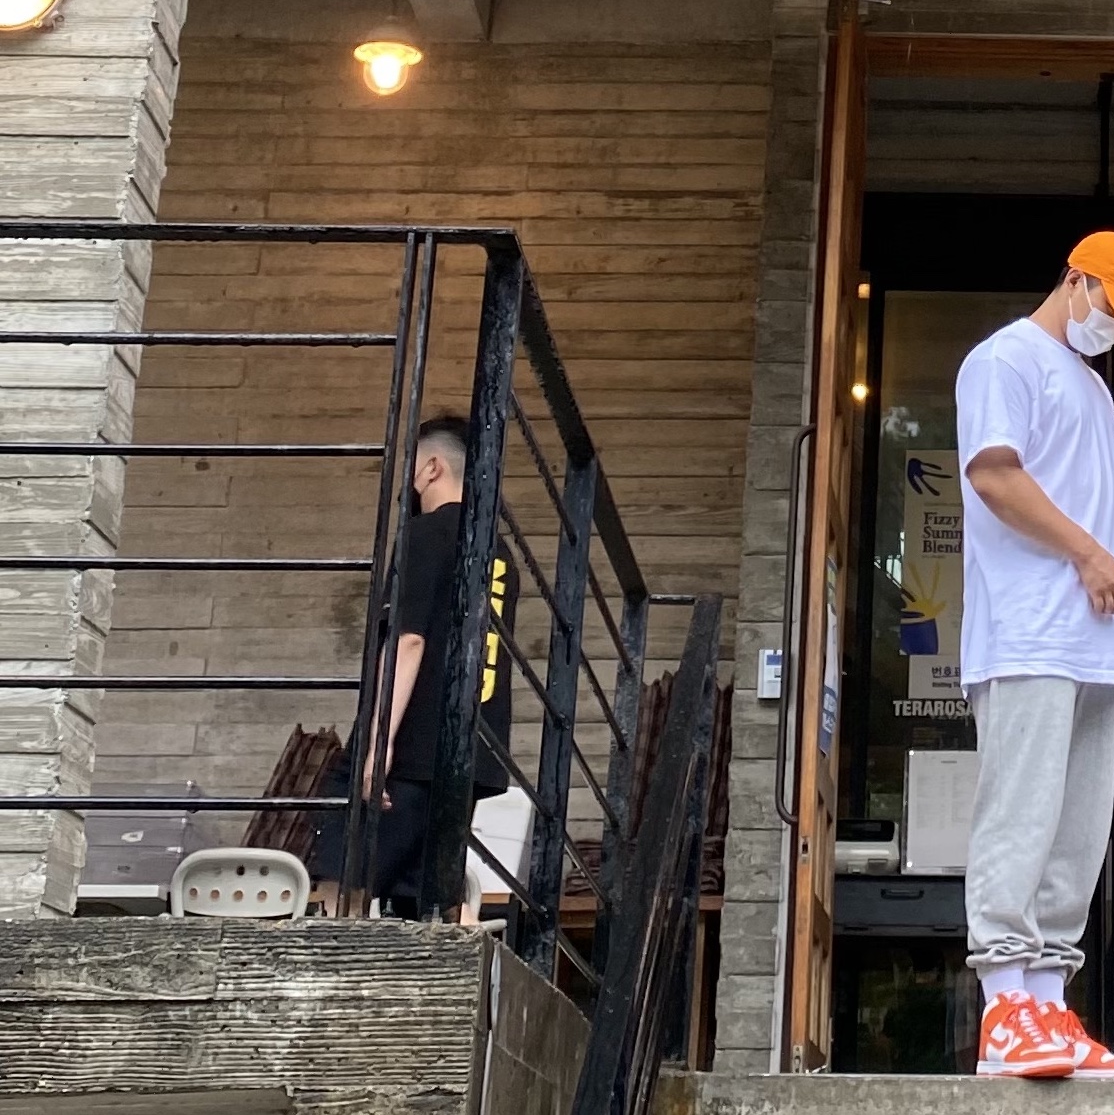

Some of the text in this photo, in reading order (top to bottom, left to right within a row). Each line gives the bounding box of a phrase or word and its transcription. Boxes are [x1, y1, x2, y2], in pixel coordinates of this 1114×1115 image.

[923, 511, 960, 528] Fizzy
[922, 526, 963, 539] Summ
[922, 540, 962, 553] Blend
